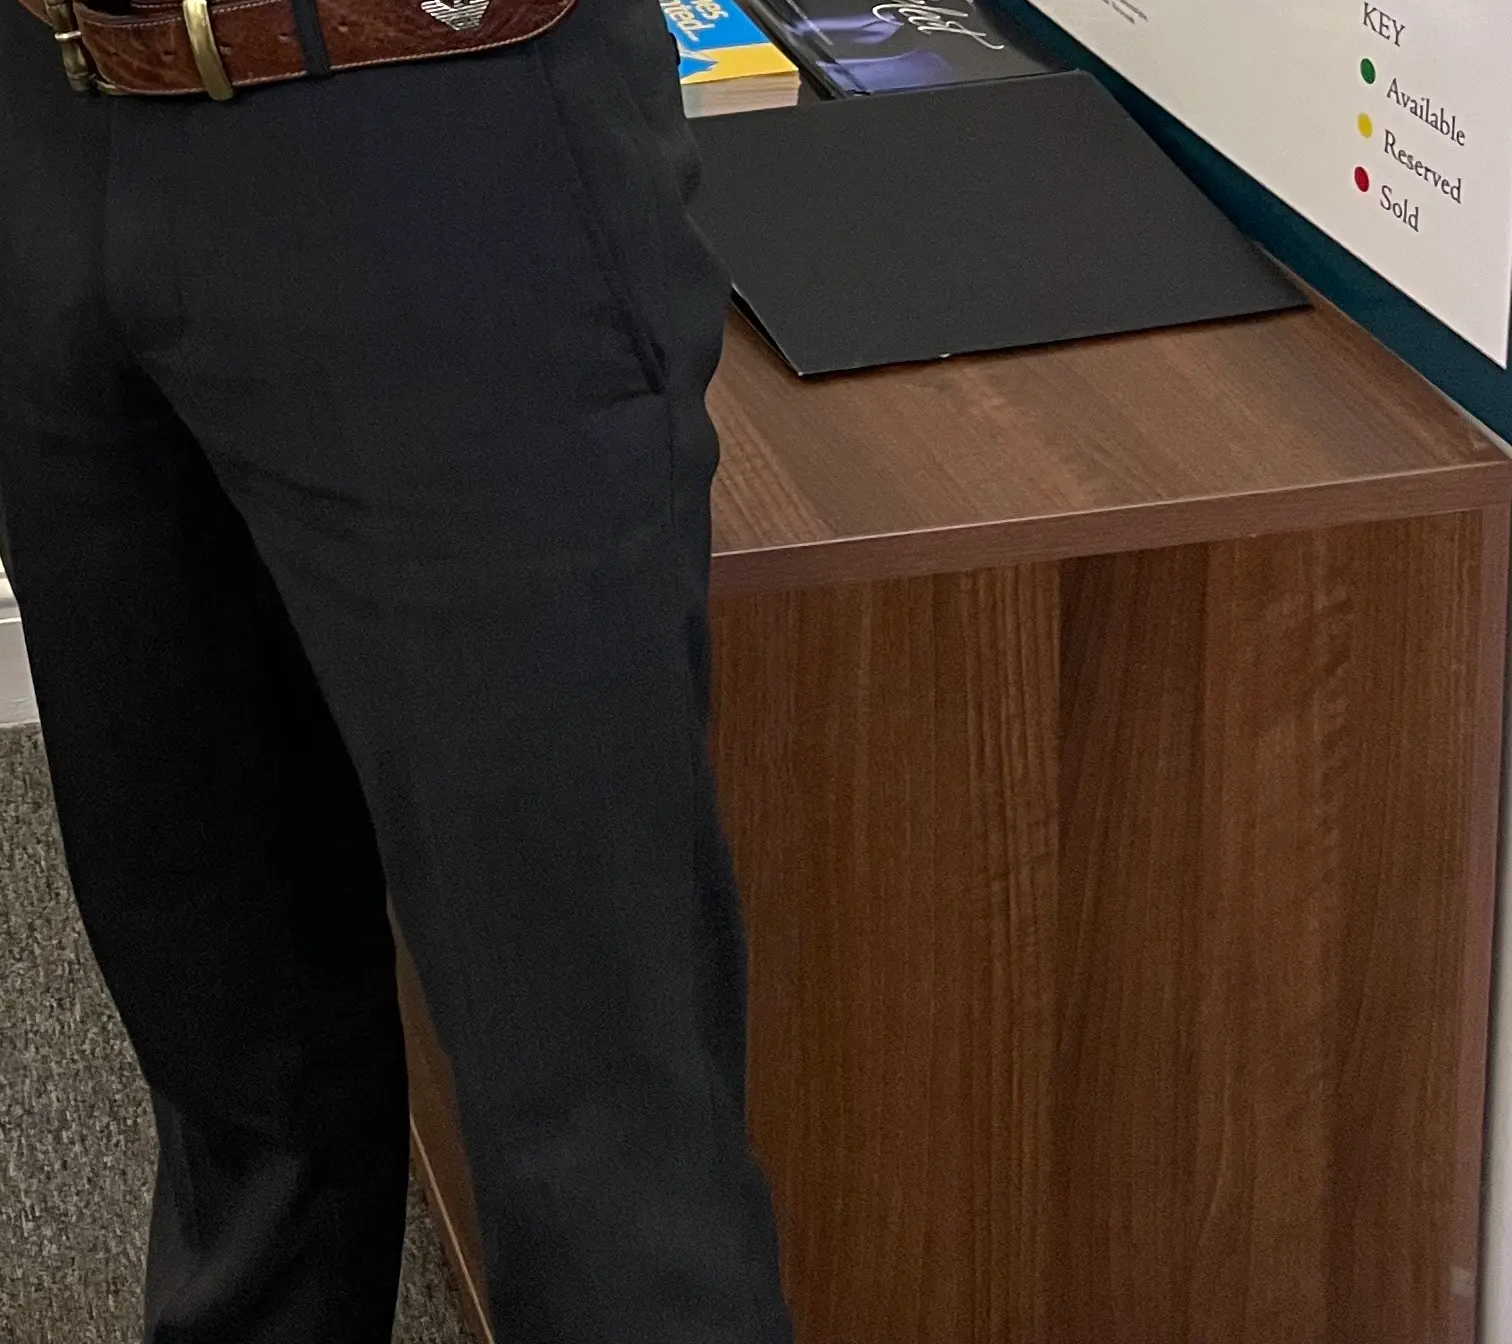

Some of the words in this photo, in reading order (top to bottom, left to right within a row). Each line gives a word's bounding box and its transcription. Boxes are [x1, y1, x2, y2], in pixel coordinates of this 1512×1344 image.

[1361, 1, 1406, 48] KEY
[1385, 77, 1467, 147] Available
[1383, 128, 1463, 205] Reserved
[1379, 184, 1420, 233] Sold
